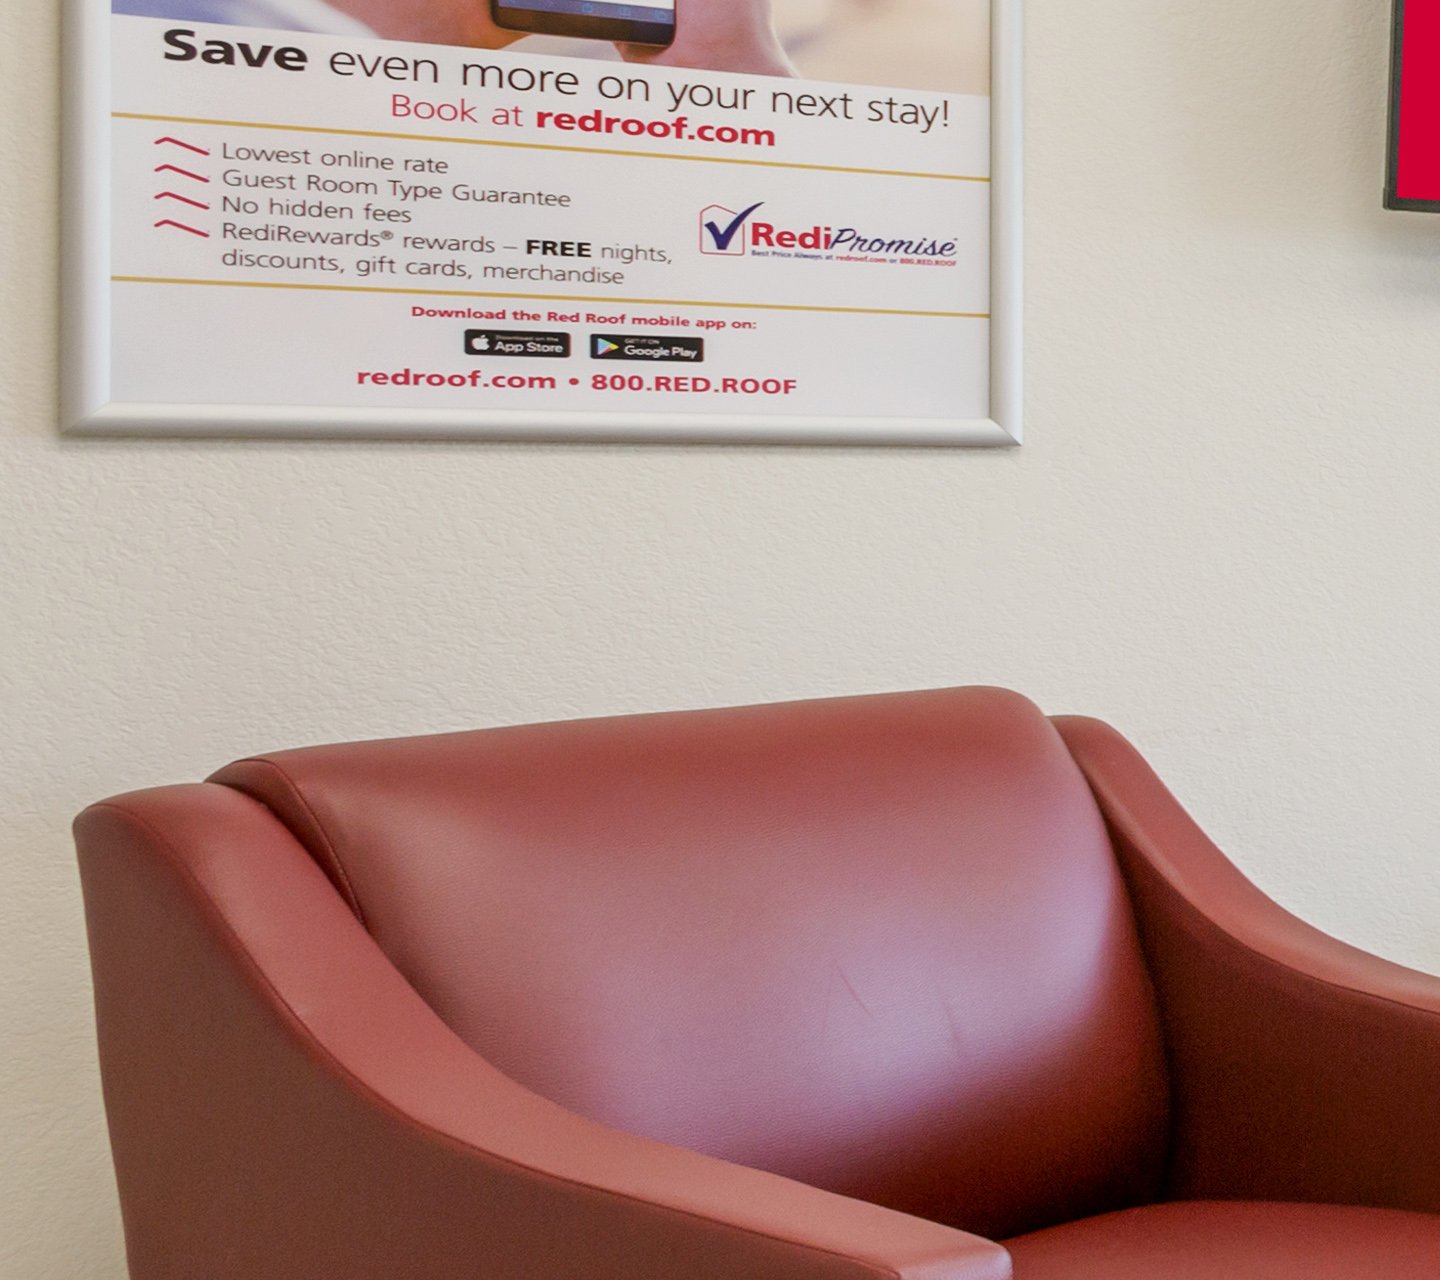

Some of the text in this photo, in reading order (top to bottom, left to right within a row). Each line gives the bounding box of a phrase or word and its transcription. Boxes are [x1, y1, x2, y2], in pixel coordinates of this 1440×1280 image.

[163, 28, 950, 132] Save even more on your next stay!
[390, 94, 776, 145] Book at redroof.com
[222, 143, 449, 173] Lowest online rate
[222, 169, 572, 208] Guest Room Type Guarantee
[222, 196, 412, 223] No hidden fees
[222, 249, 625, 284] discounts, gift cards, merchandise
[403, 236, 496, 254] rewards
[526, 239, 592, 259] FREE
[600, 244, 673, 268] nights,
[411, 307, 756, 330] Download the Red Roof mobile app on:
[494, 342, 563, 353] App Store
[624, 345, 697, 359] Google Play
[357, 369, 797, 395] redroof.com 800.RED.ROOF
